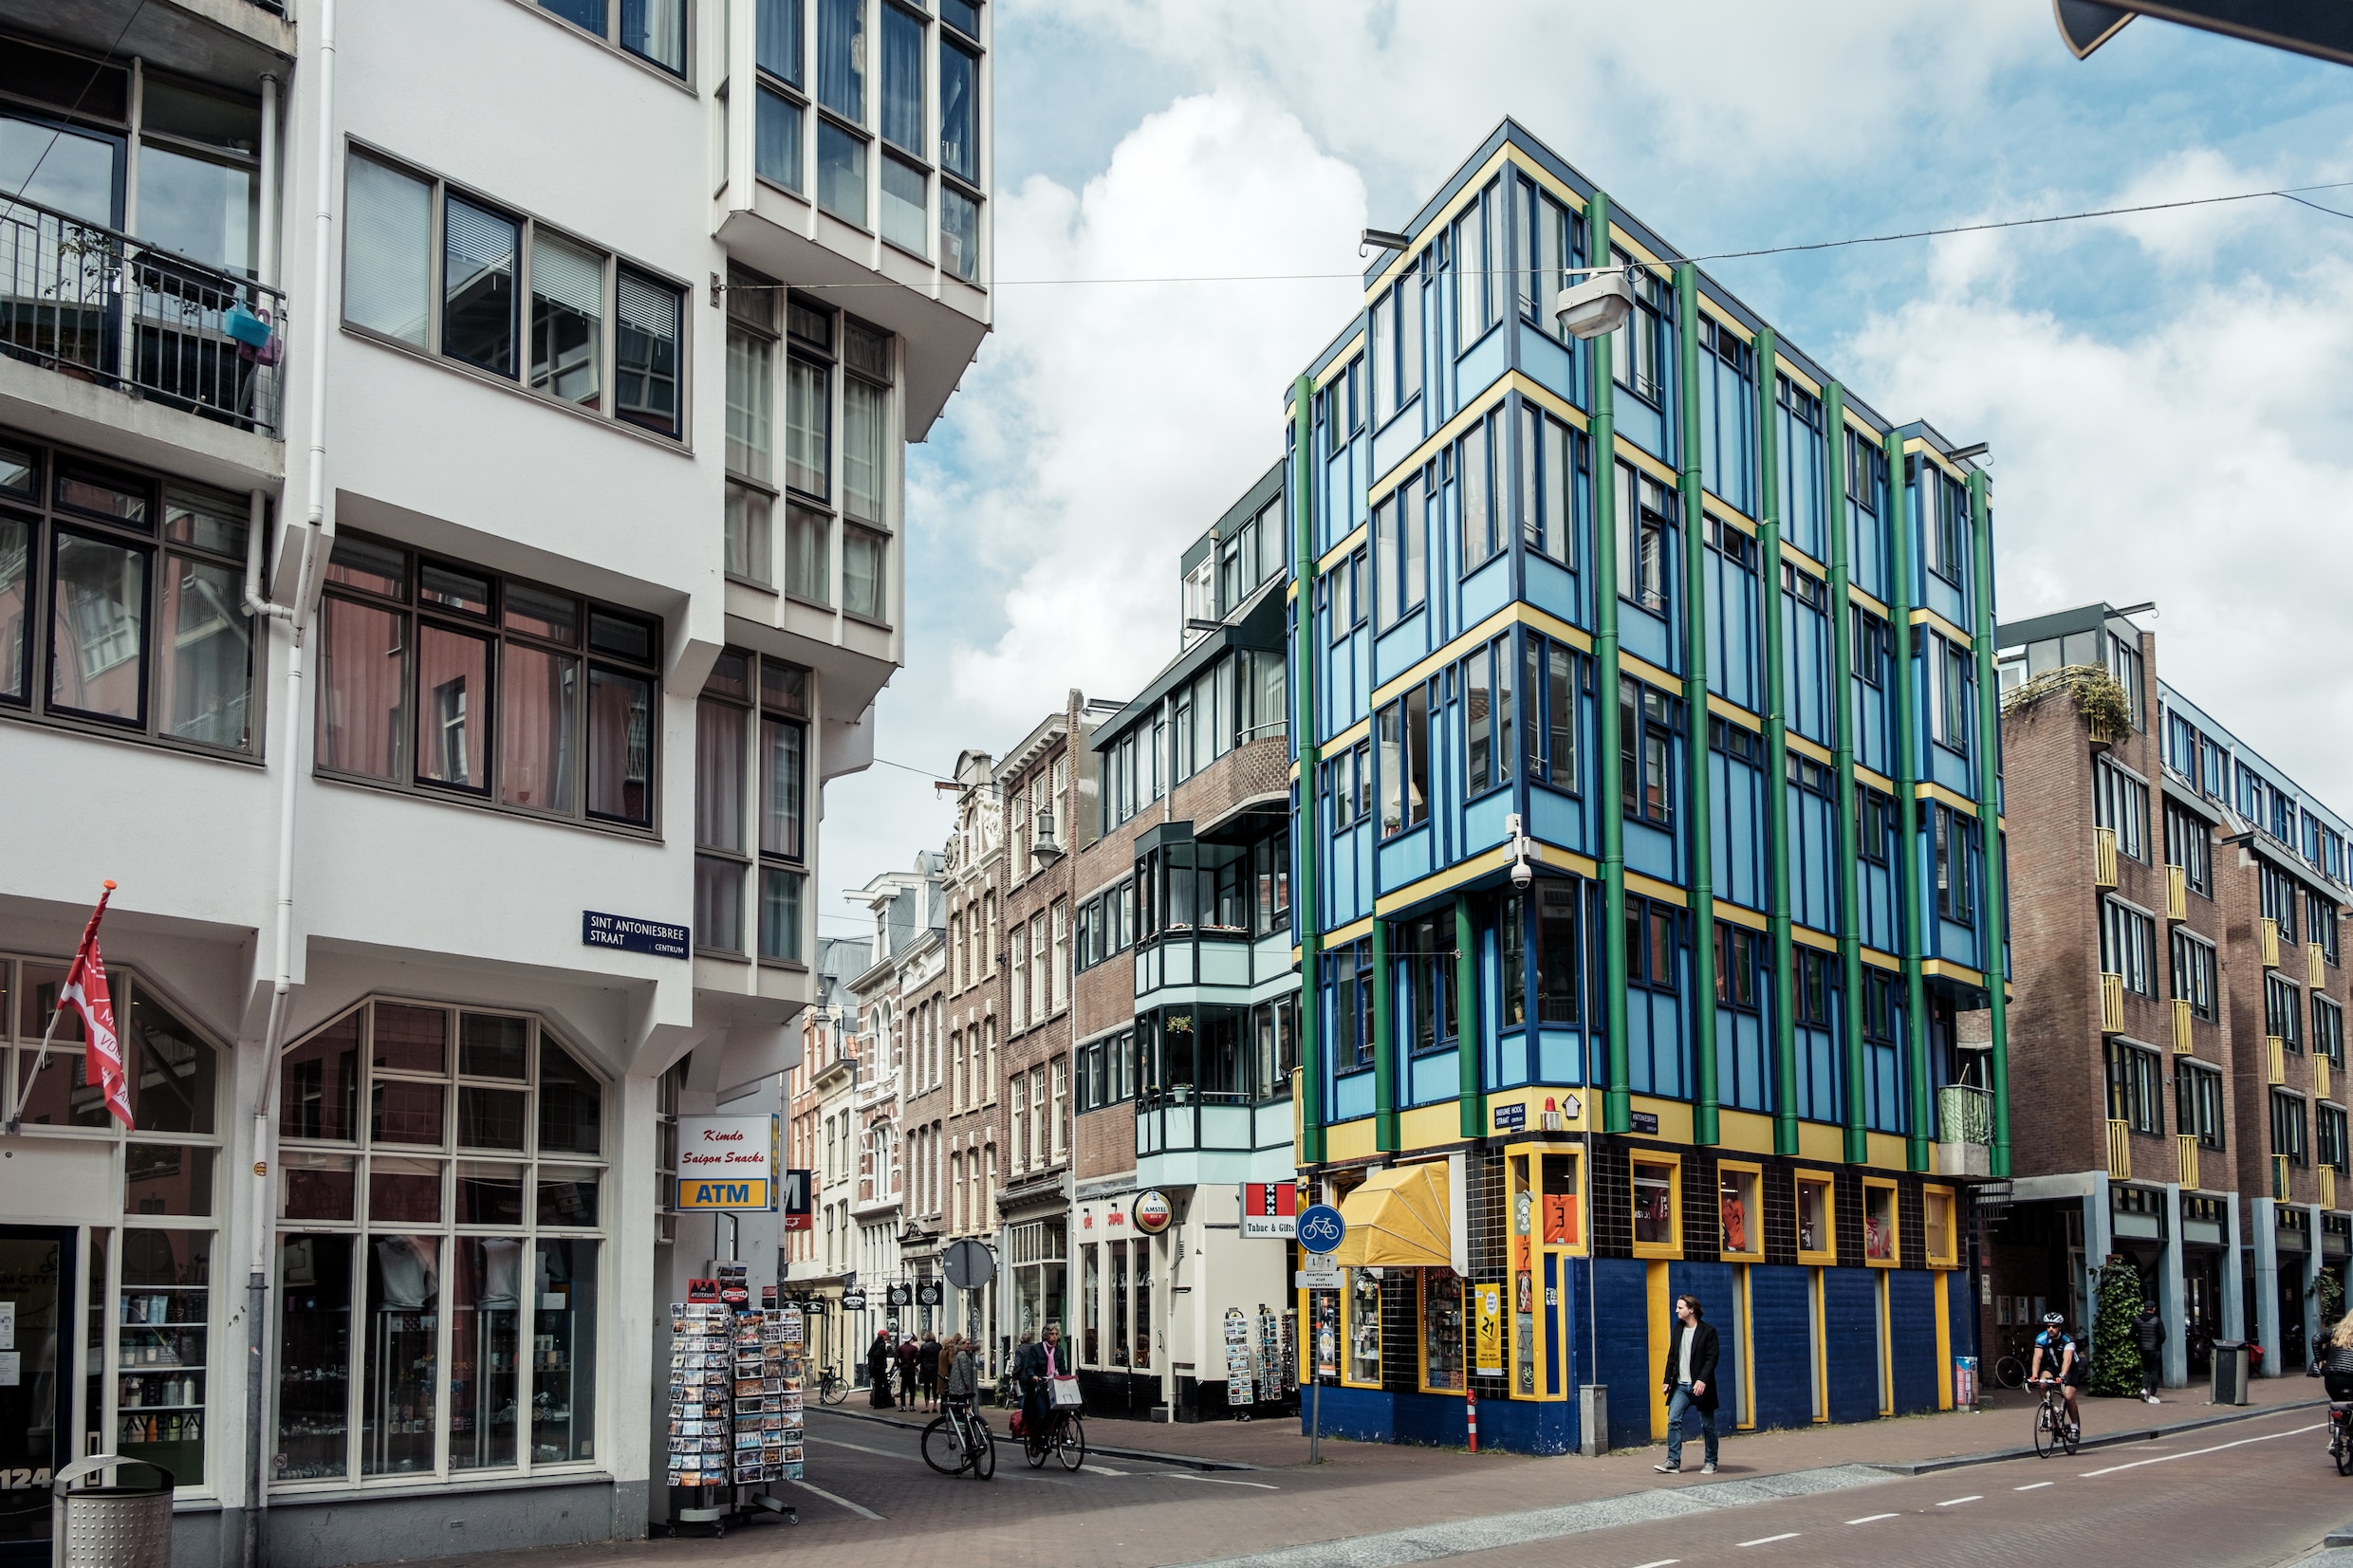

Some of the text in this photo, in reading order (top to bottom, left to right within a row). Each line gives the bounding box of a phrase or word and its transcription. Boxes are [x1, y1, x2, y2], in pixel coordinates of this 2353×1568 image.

[590, 915, 684, 941] SINT ANTONIESBREE
[590, 930, 624, 946] STRAAT
[655, 943, 684, 954] CENTRUM
[703, 1129, 744, 1141] Kimdo
[682, 1151, 765, 1166] Saigon Snacks
[695, 1184, 749, 1204] ATM
[1555, 1207, 1565, 1227] 3
[1248, 1223, 1295, 1232] Tabac & Gifts
[19, 1275, 49, 1284] CITY
[1482, 1316, 1494, 1337] 21
[122, 1412, 200, 1433] AVEDA
[0, 1467, 54, 1489] 124
